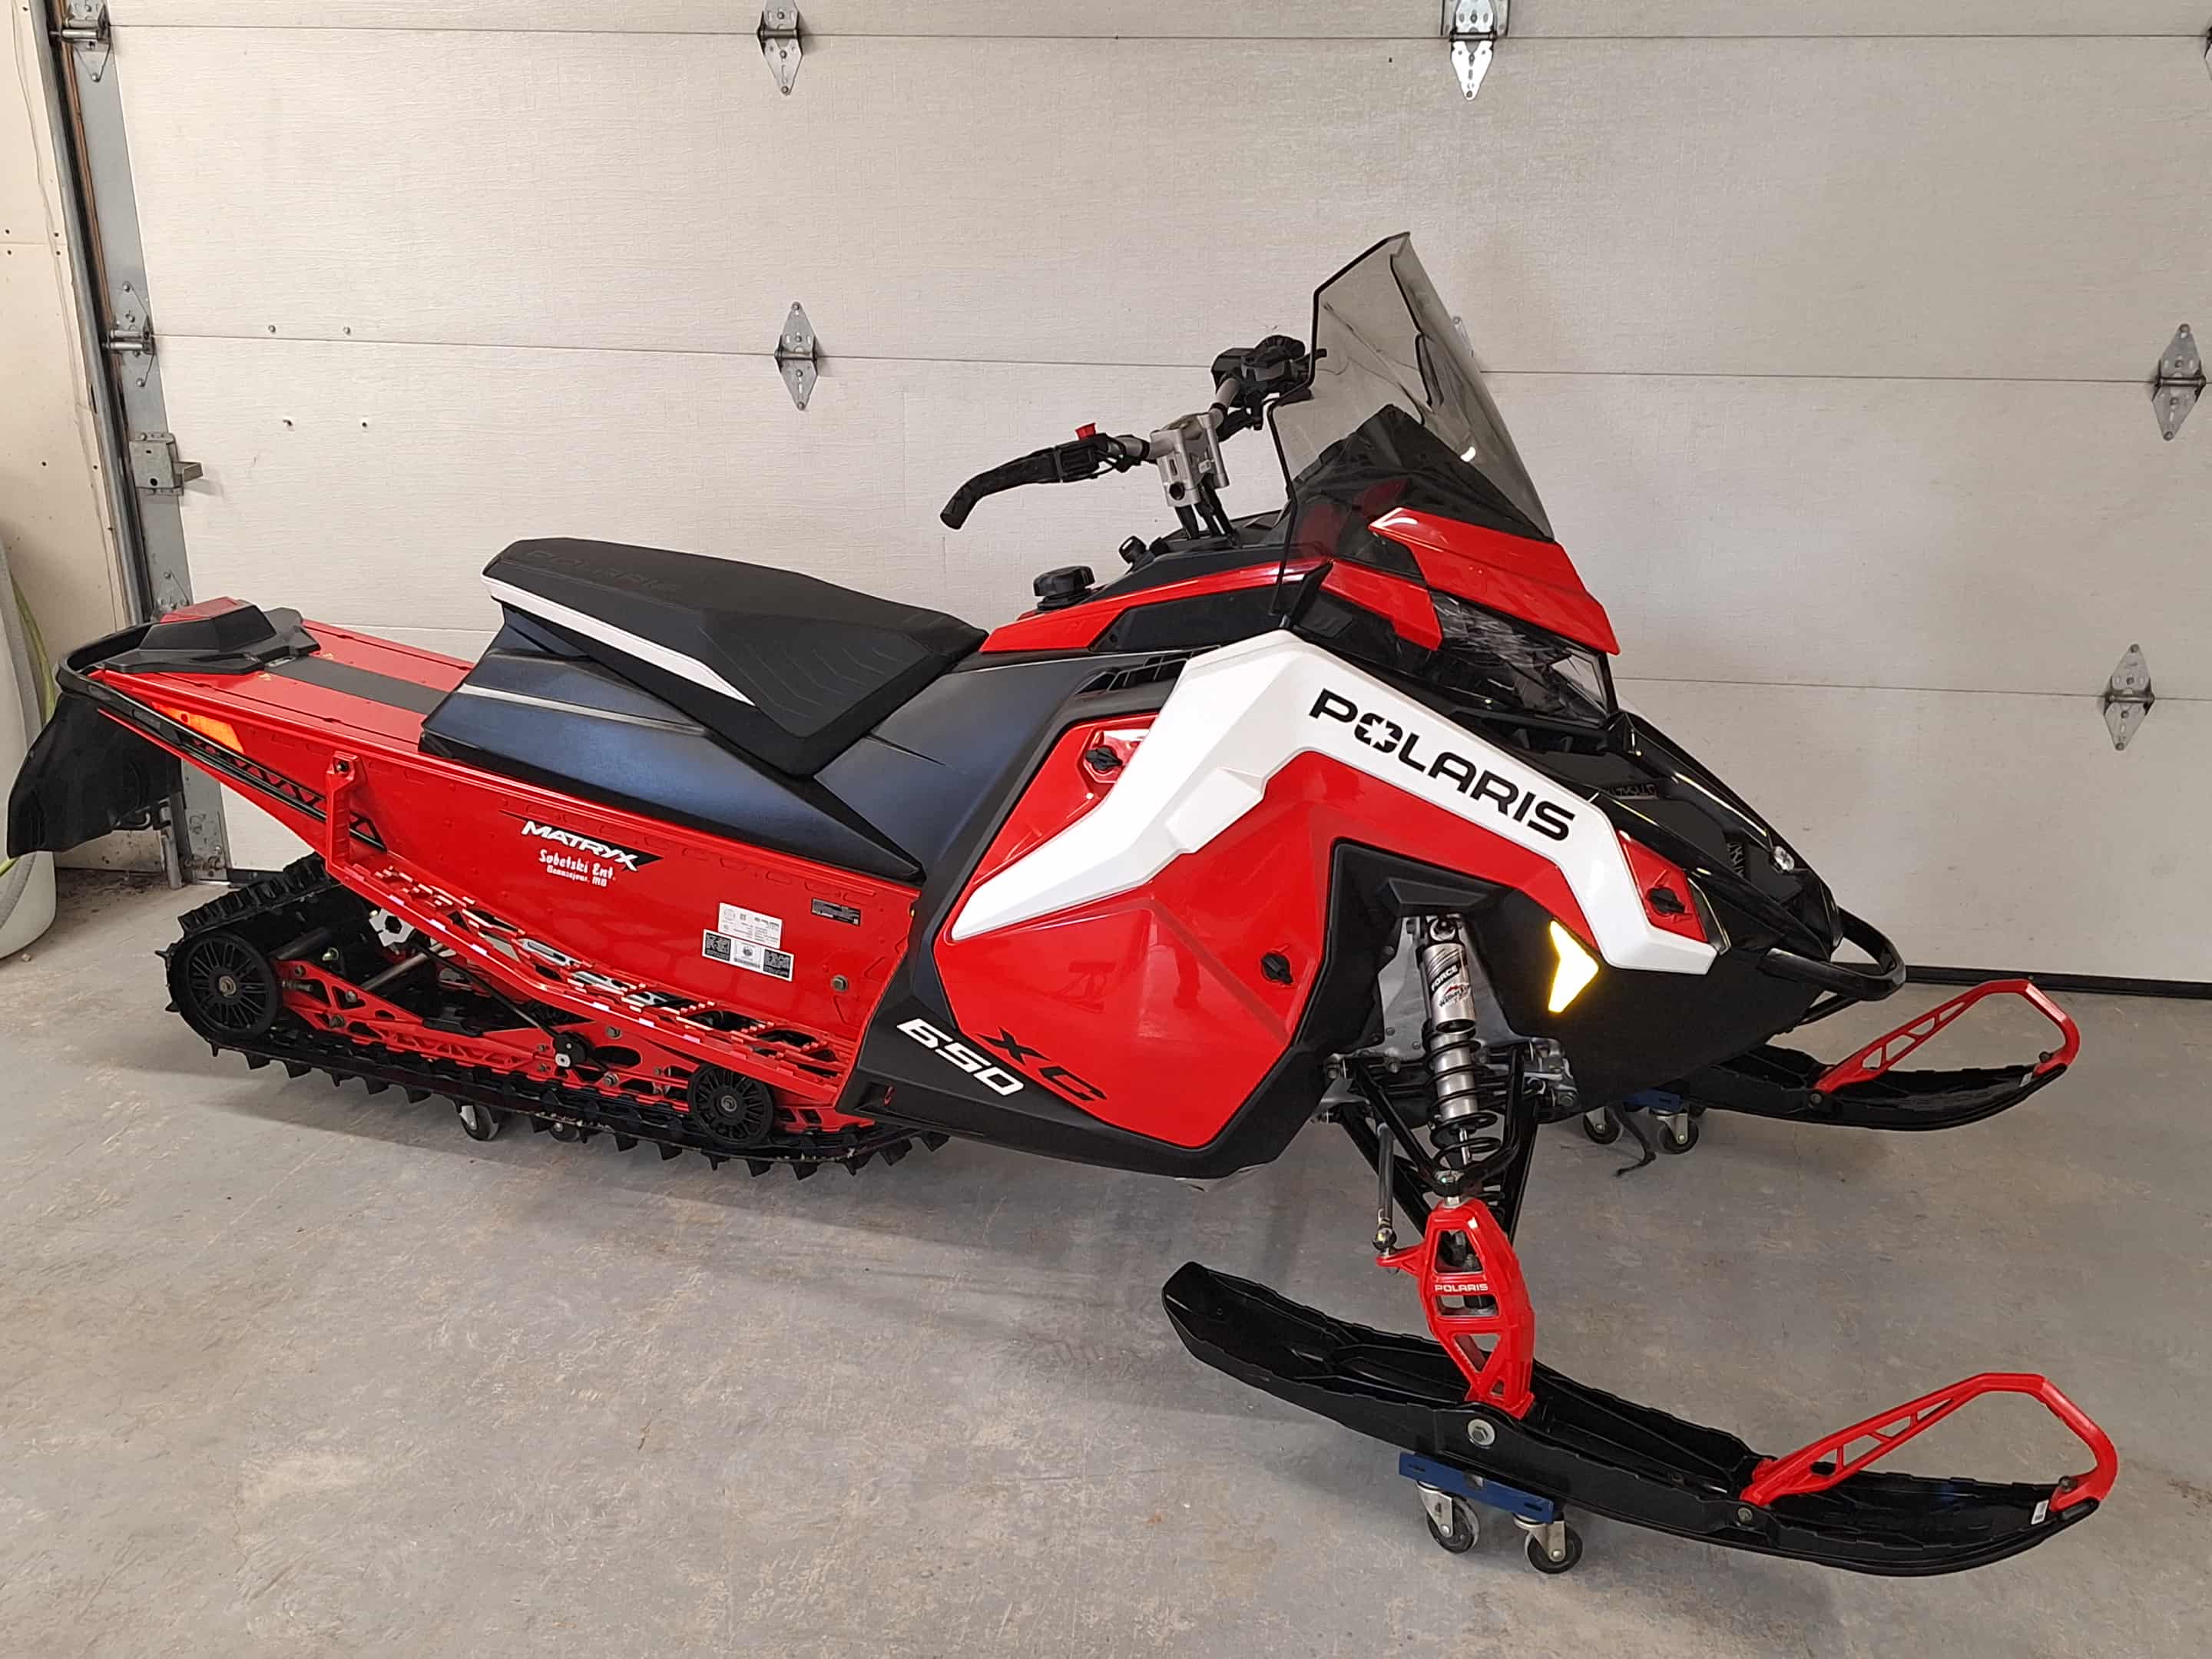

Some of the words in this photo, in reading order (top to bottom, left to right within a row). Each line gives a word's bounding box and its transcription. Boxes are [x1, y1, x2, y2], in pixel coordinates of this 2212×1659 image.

[1308, 687, 1576, 842] POLARIS
[521, 820, 639, 873] MATRYX
[591, 863, 616, 882] Ent.
[896, 1018, 1025, 1096] 650
[976, 1026, 1108, 1102] XC
[1434, 1283, 1488, 1293] POLARIS
